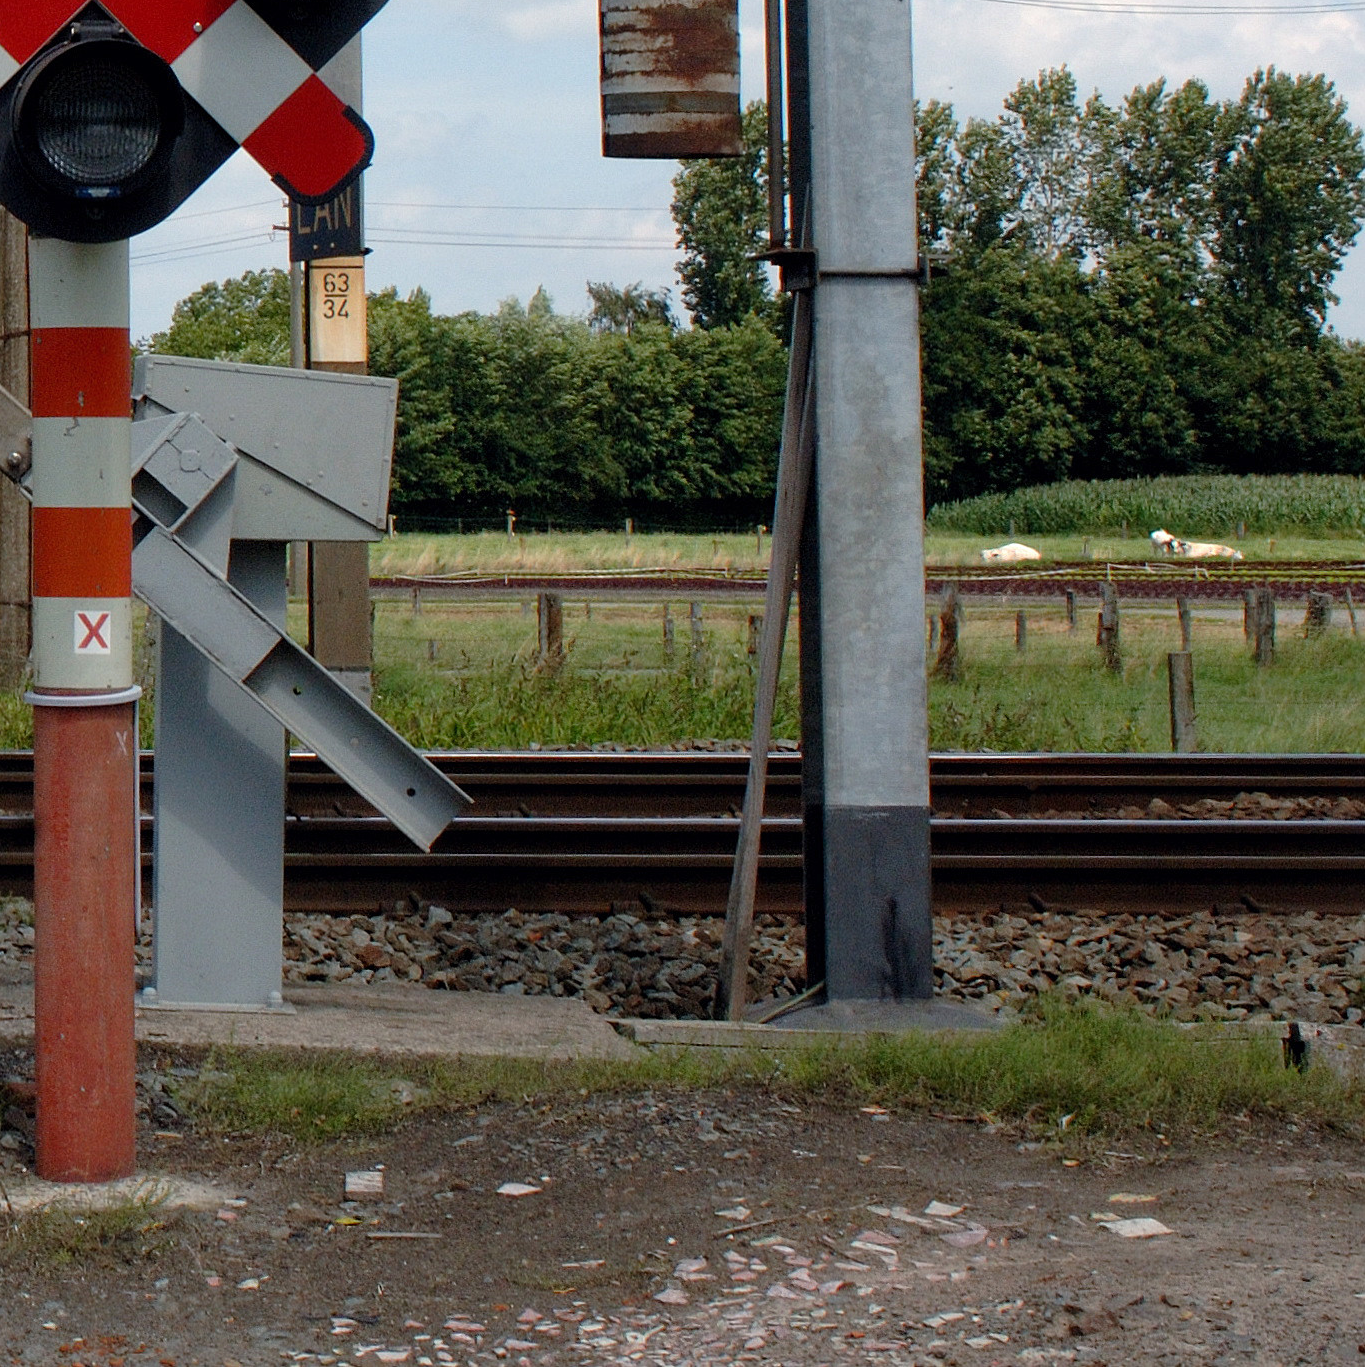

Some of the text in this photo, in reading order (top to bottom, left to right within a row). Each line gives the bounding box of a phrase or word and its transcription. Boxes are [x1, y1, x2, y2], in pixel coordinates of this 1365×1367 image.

[323, 272, 349, 294] 63
[323, 298, 349, 319] 34
[77, 613, 109, 648] X
